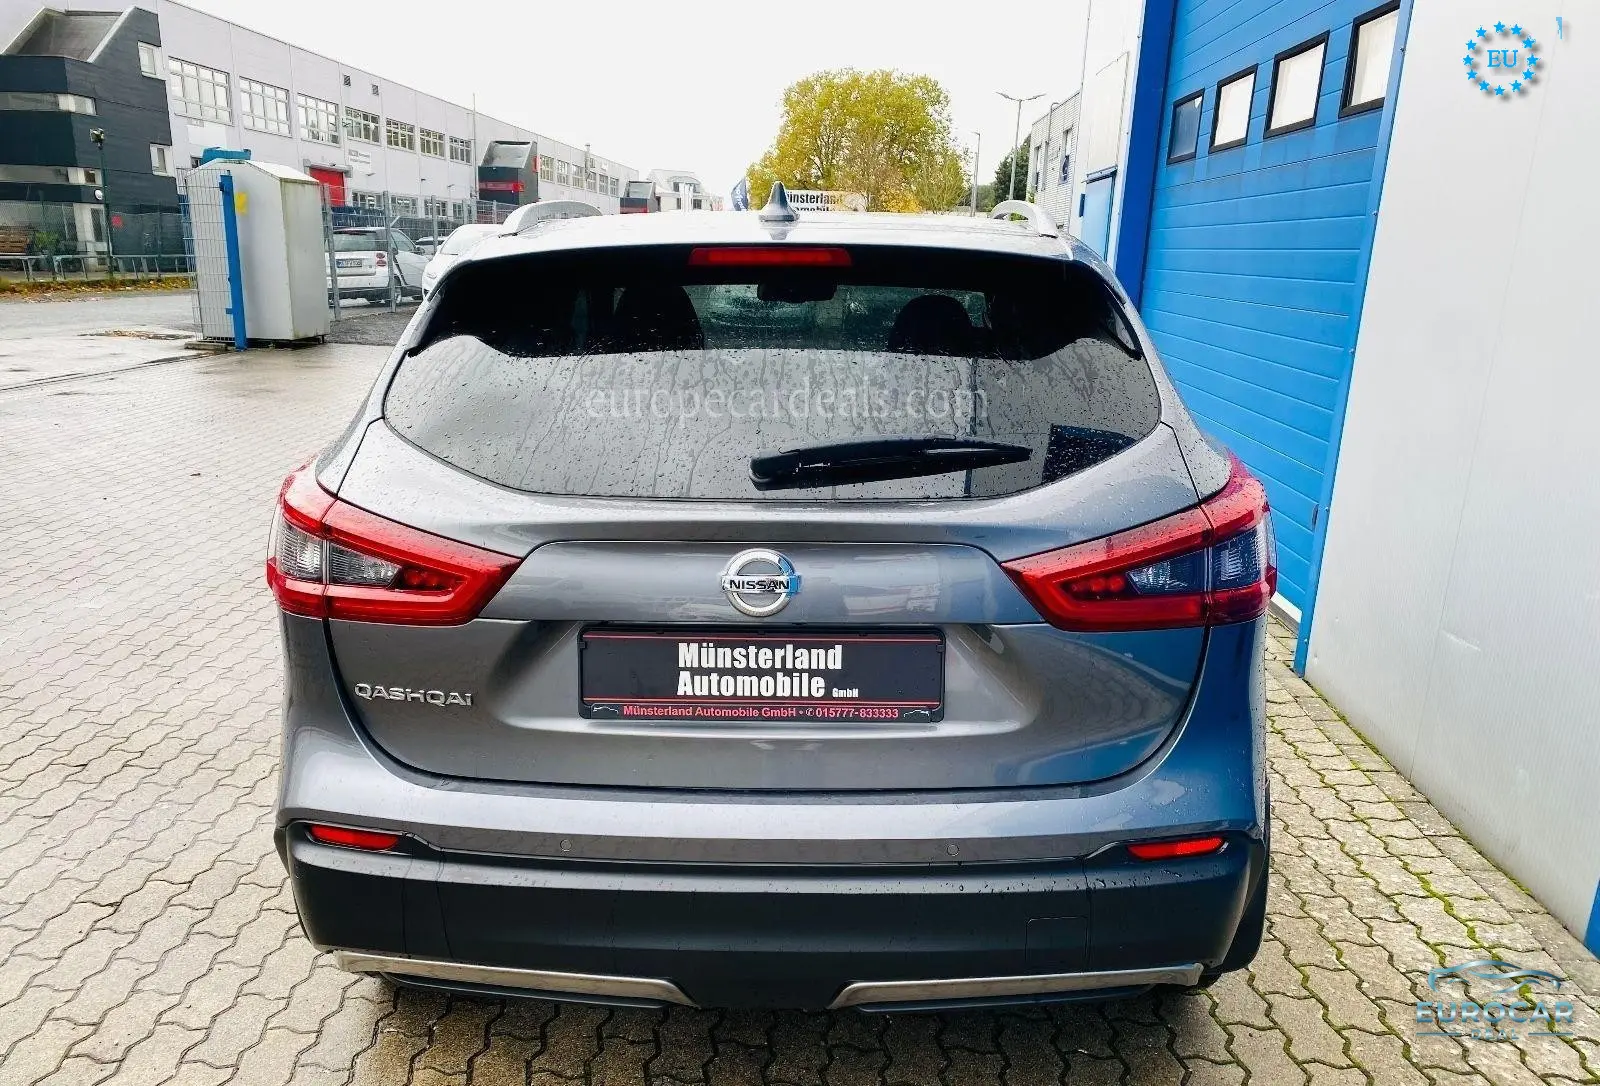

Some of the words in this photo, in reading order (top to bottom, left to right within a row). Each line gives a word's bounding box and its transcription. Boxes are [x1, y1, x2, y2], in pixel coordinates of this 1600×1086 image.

[729, 579, 789, 590] NISSAN
[678, 642, 843, 670] Münsterland
[354, 683, 472, 707] QASHQAI
[677, 670, 826, 698] Automobile
[832, 687, 859, 698] GmbH
[623, 705, 693, 717] Münsterland
[695, 706, 759, 717] Automobile
[761, 707, 796, 718] GmbH
